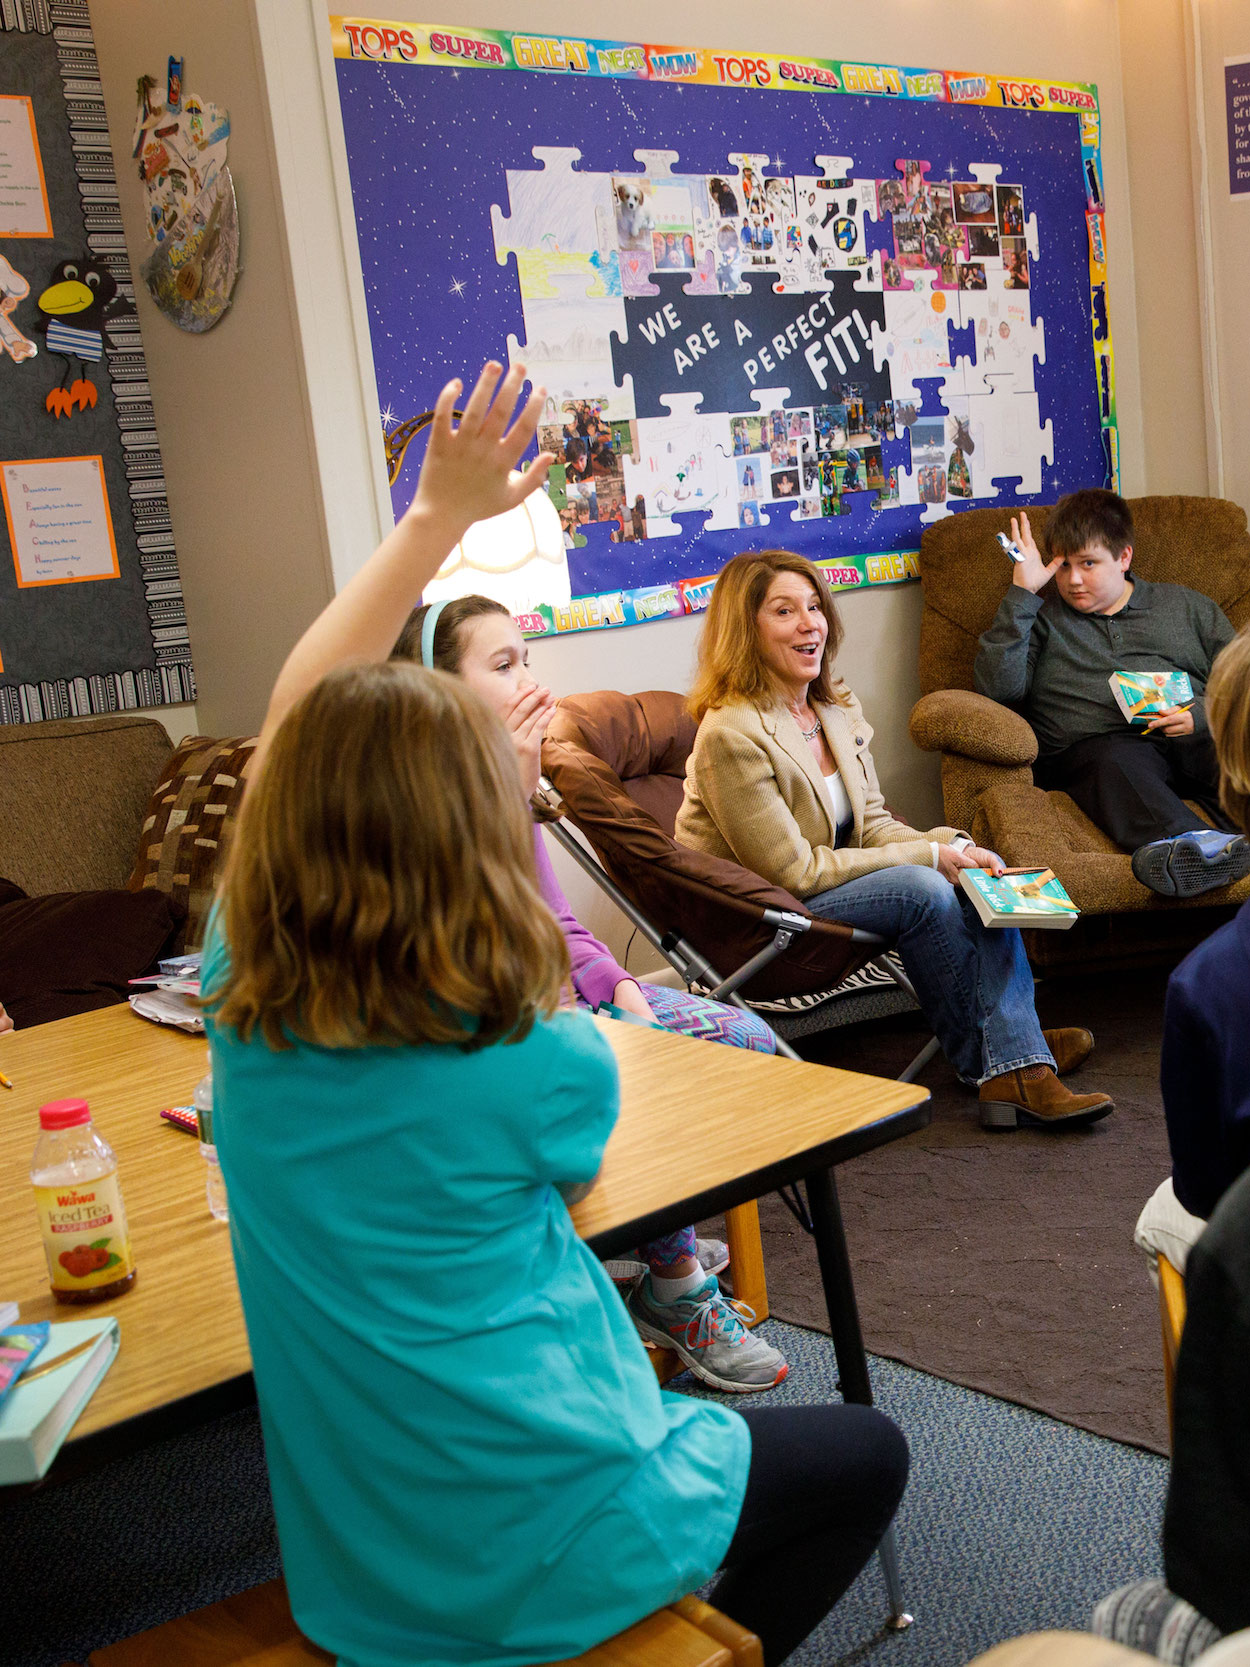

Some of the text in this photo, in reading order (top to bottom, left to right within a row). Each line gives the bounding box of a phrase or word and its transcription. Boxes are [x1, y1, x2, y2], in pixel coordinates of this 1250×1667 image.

[343, 25, 1098, 110] TOPS SUPER GREAT NEAT WOW TOPS SUPER GREAT NEAT WOW TOPS SUPER
[1234, 108, 1245, 119] of
[1235, 124, 1246, 136] by
[1236, 138, 1249, 149] for
[638, 303, 682, 345] WE
[743, 292, 836, 385] PERFECT
[673, 319, 753, 375] ARE A
[803, 309, 873, 391] FIT!
[865, 552, 921, 583] GREAT
[553, 592, 626, 631] GREAT
[633, 588, 681, 621] NEAT
[48, 1204, 110, 1223] Iced Tea
[57, 1191, 95, 1207] Wawa
